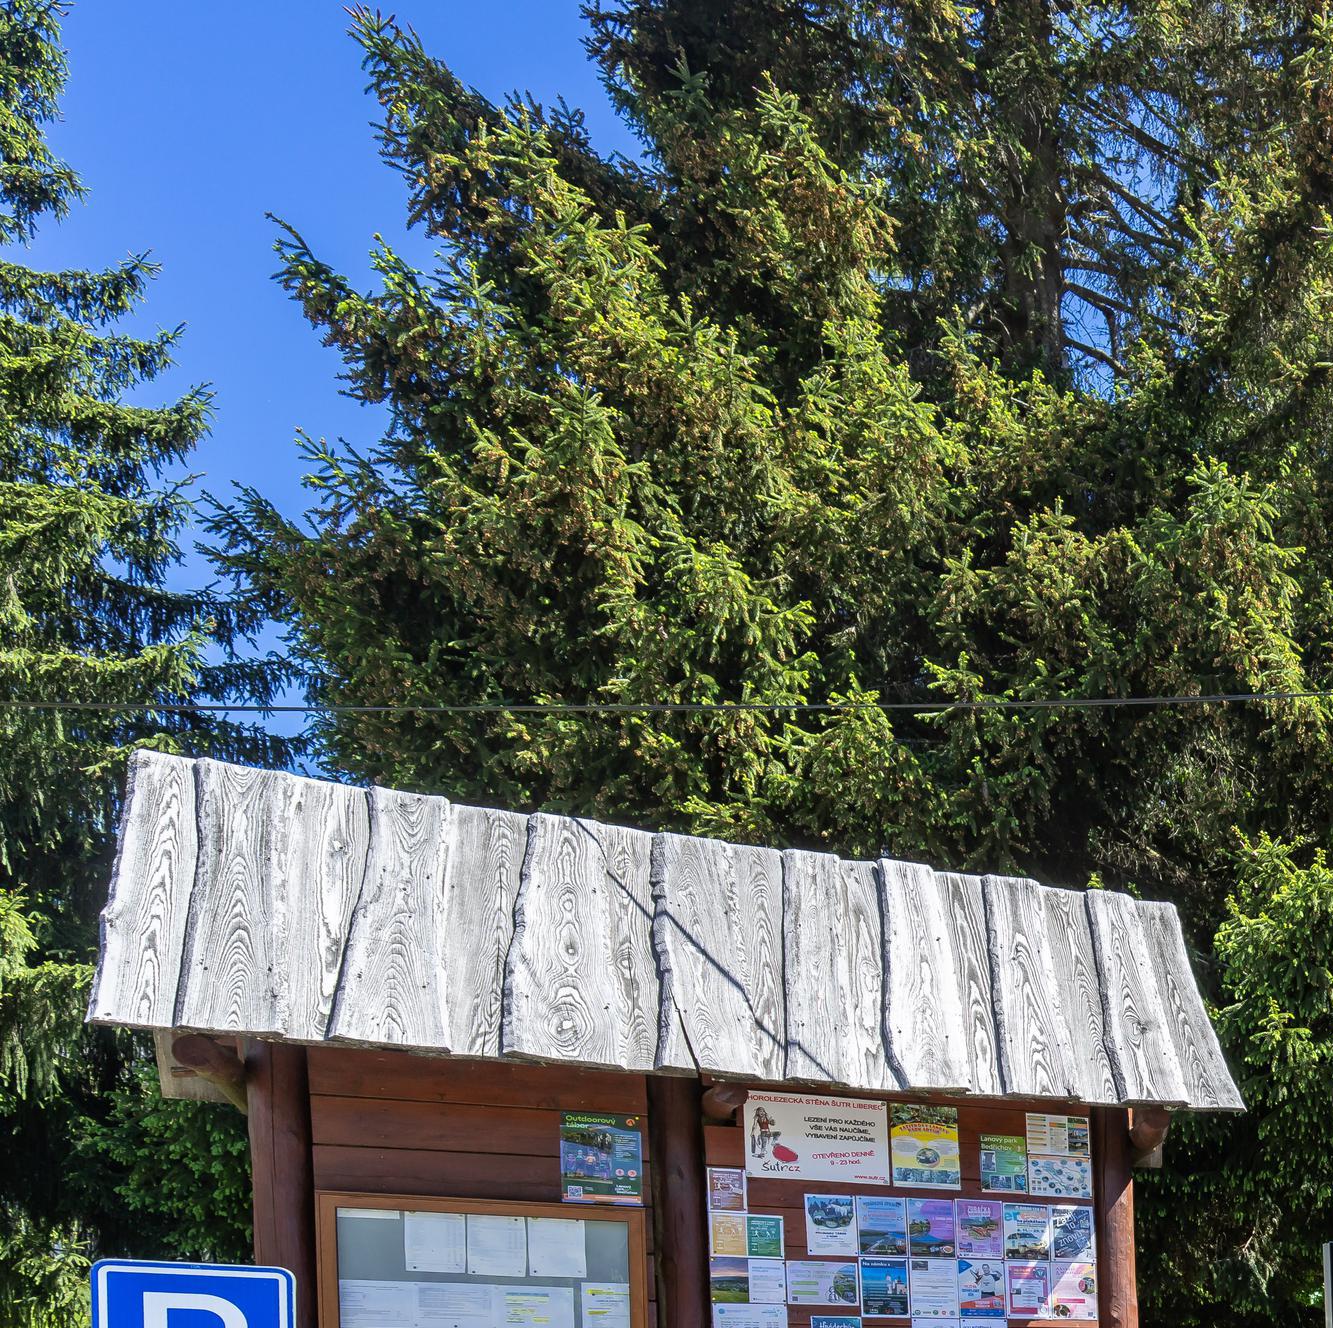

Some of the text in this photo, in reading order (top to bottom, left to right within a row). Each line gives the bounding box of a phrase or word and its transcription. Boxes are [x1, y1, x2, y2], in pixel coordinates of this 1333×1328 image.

[805, 1098, 830, 1106] STĚNA
[831, 1100, 851, 1108] ŠUTR
[852, 1103, 883, 1111] LIBEREC
[565, 1115, 616, 1125] Outdoorový
[844, 1118, 876, 1127] KAŽDÉHO
[805, 1132, 838, 1140] VYBAVENÍ
[980, 1136, 1018, 1145] Lanový park
[812, 1152, 850, 1160] OTEVŘENO
